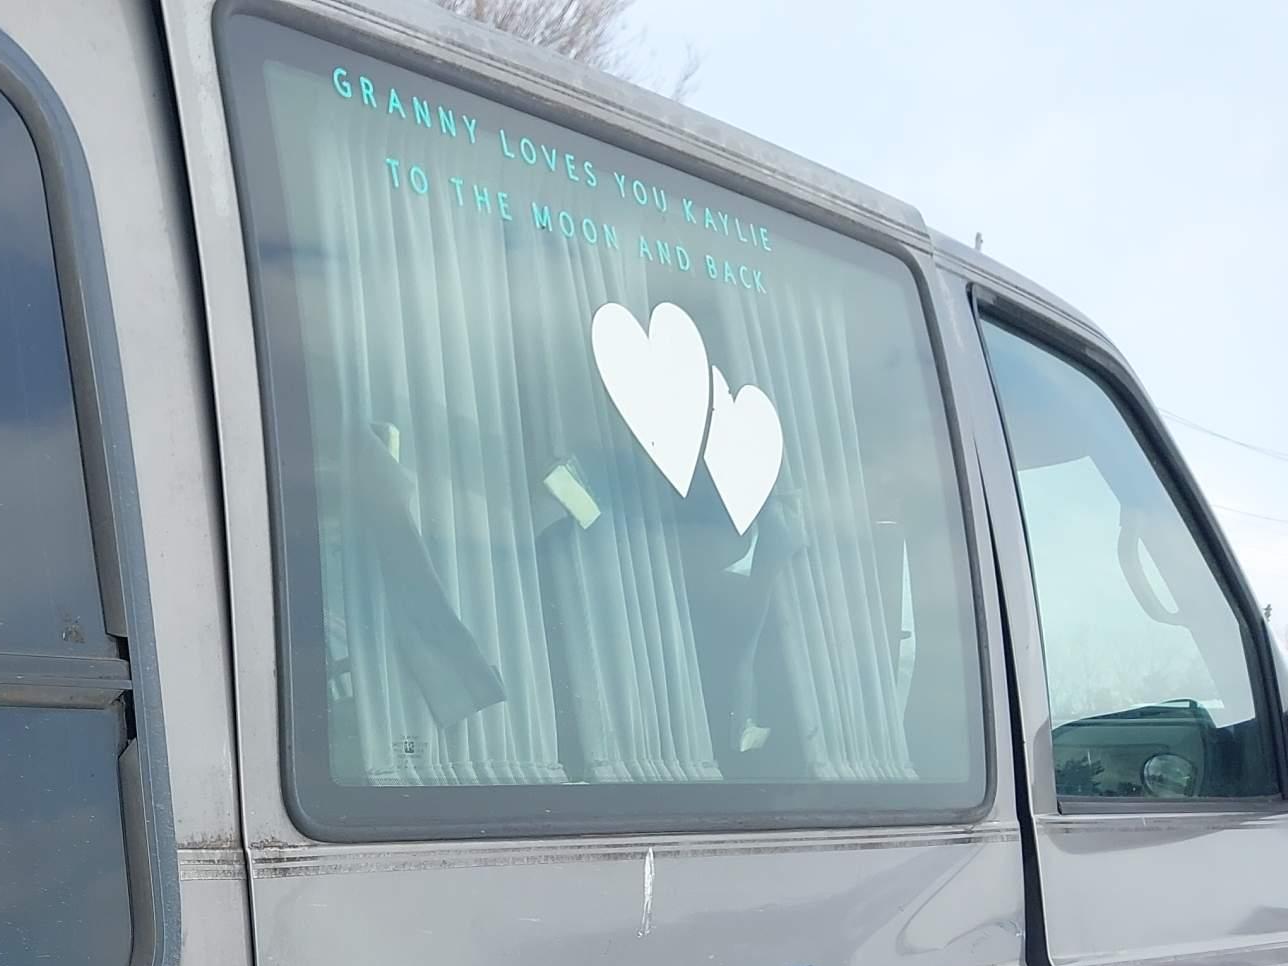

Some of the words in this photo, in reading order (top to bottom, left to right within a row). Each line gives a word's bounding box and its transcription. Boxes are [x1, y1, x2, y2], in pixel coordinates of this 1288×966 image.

[331, 66, 478, 144] GRANNY
[499, 130, 599, 188] LOVES
[614, 172, 668, 214] YOU
[682, 199, 773, 252] KAYLIE
[385, 157, 431, 196] TO
[449, 175, 513, 222] THE
[530, 202, 619, 251] MOON
[638, 236, 692, 273] AND
[705, 256, 768, 294] BACK
